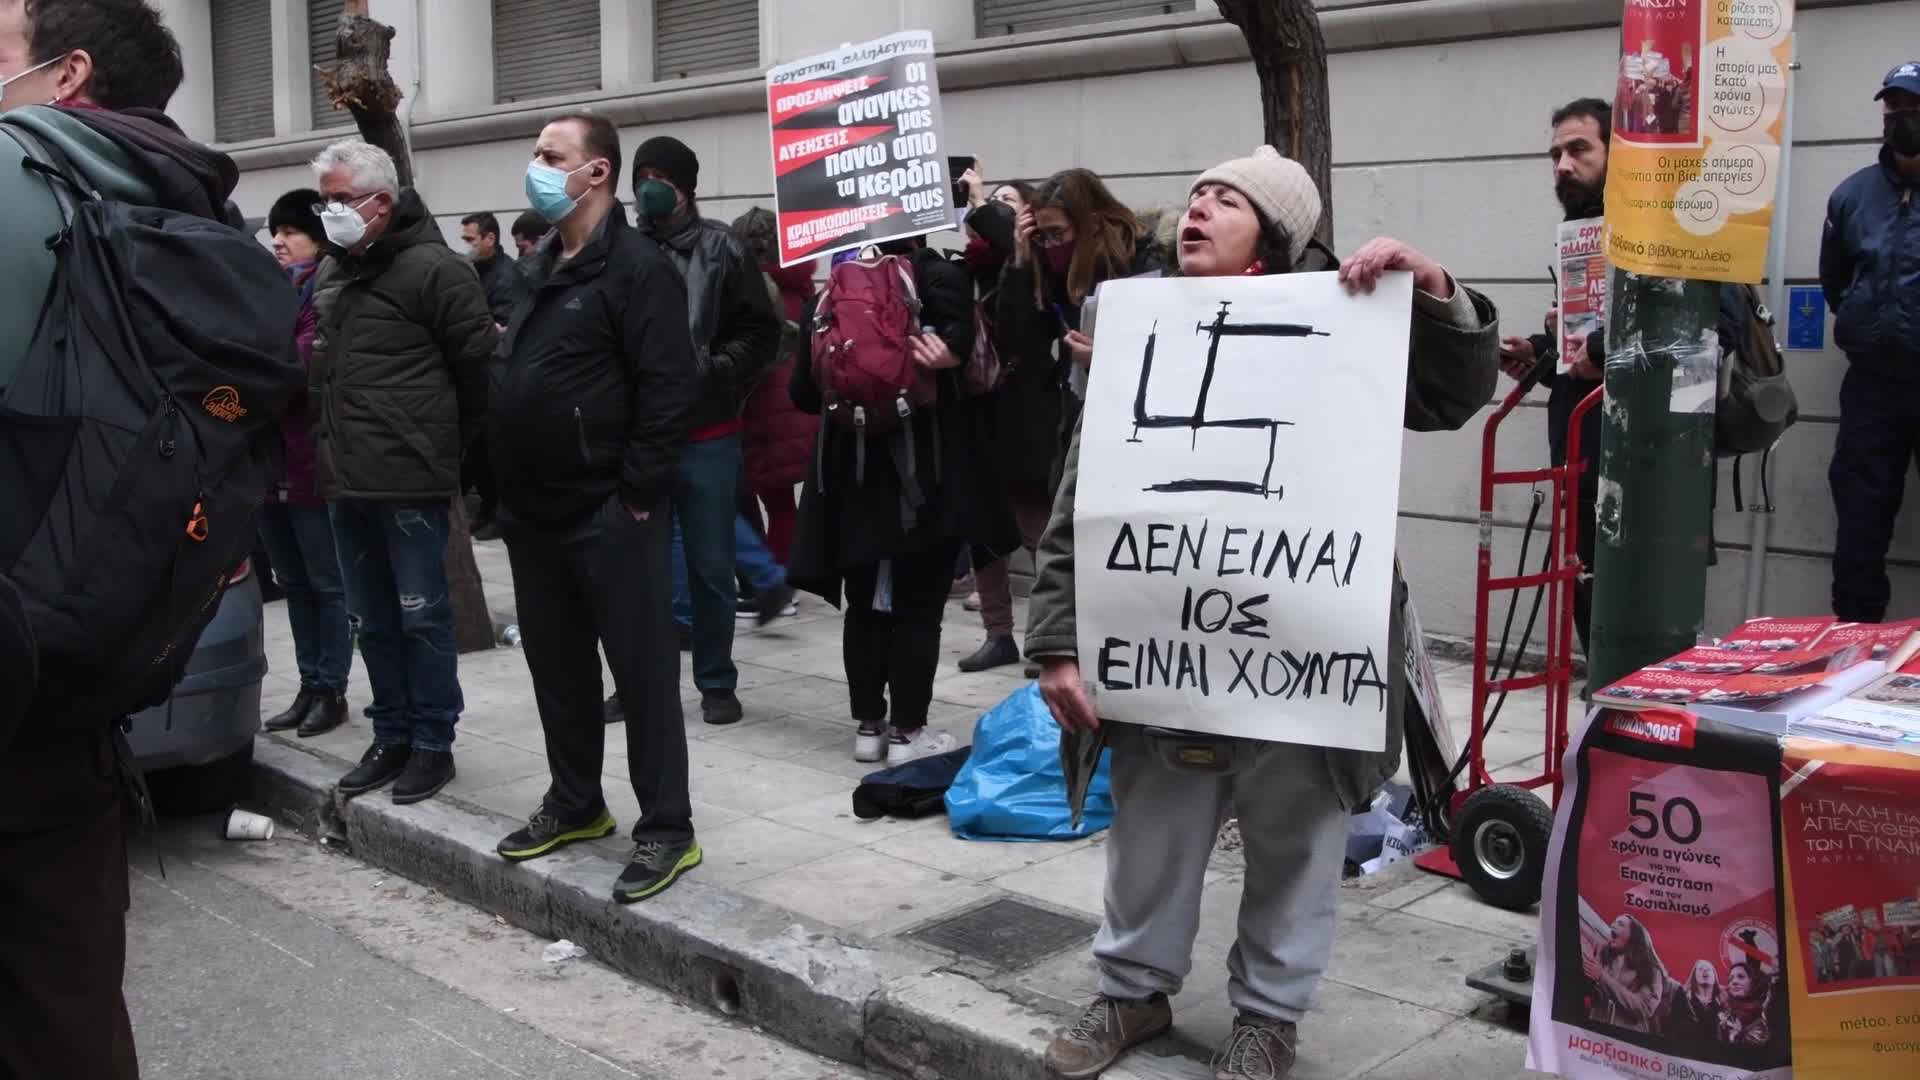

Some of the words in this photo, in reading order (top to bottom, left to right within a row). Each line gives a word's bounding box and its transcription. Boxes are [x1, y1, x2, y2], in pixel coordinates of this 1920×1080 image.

[1716, 46, 1725, 57] Η
[1715, 61, 1754, 76] ιστορία
[1757, 65, 1778, 76] μας
[1714, 75, 1747, 87] Εκατό
[776, 75, 870, 113] ΠΡΟΣΛΗΨΕΙΣ
[1713, 90, 1751, 103] χρόνια
[1713, 103, 1755, 116] αγώνες
[897, 110, 932, 136] μας
[778, 129, 850, 162] ΑΥΞΗΣΕΙΣ
[1658, 156, 1671, 168] Οι
[1673, 156, 1708, 169] μάχες
[1712, 157, 1754, 171] σήμερα
[836, 178, 855, 197] τα
[1654, 172, 1675, 182] στη
[1703, 171, 1753, 184] απεργίες
[900, 188, 944, 214] τους
[1660, 198, 1713, 210] αφιέρωμα
[786, 202, 889, 241] ΚΡΑΤΙΚΟΠΟΙΗΣΕΙΣ
[1579, 226, 1602, 239] εργ
[1647, 243, 1731, 262] βιβλιοπωλείο
[1106, 518, 1208, 577] ΔΕΝ
[1217, 525, 1362, 588] ΕΙΝΑΙ
[1181, 586, 1271, 639] ΙΟΣ
[1098, 636, 1209, 697] ΕΙΝΑΙ
[1227, 645, 1388, 712] ΧΟΥΝΤΑ
[1628, 791, 1702, 845] 50
[1800, 801, 1814, 814] Η
[1819, 799, 1890, 820] ΠΑΛΗ
[1611, 839, 1659, 857] χρόνια
[1663, 848, 1721, 867] αγώνες
[1806, 839, 1842, 851] ΤΩΝ
[1621, 866, 1713, 892] Επανάσταση
[1664, 865, 1681, 874] την
[1625, 893, 1711, 916] Σοσιαλισμό
[1568, 1033, 1663, 1072] μαρξιστικό
